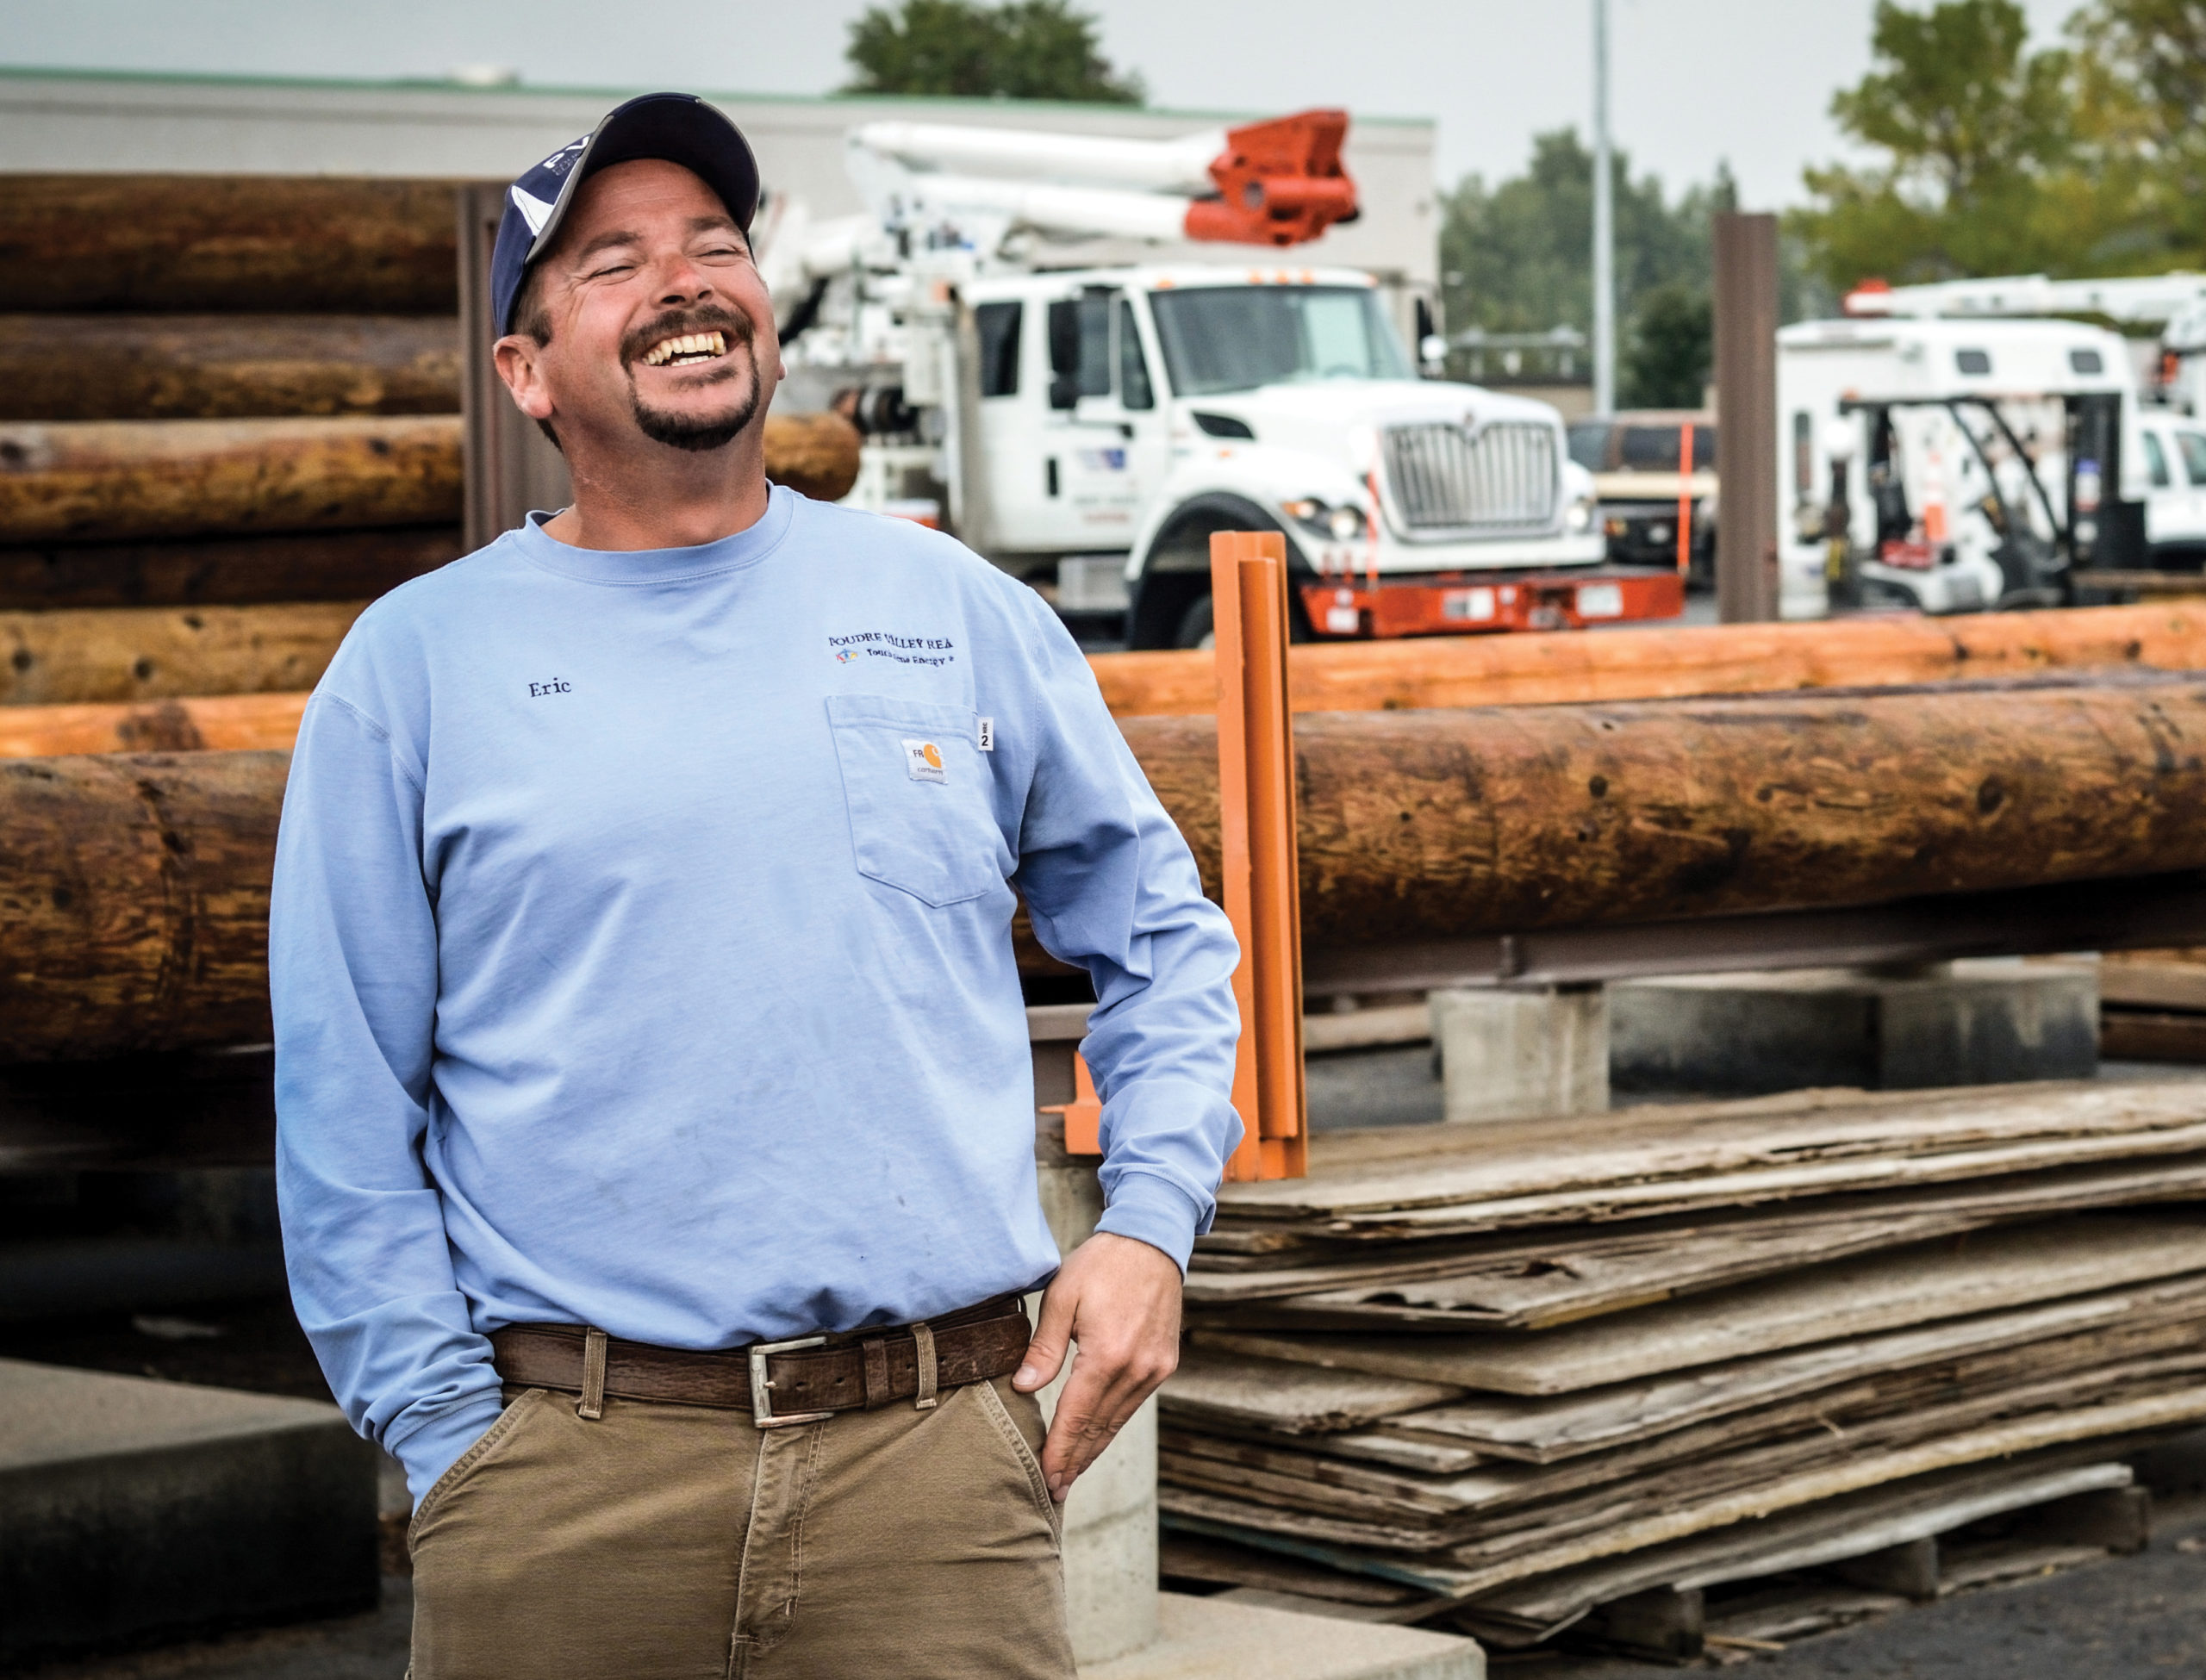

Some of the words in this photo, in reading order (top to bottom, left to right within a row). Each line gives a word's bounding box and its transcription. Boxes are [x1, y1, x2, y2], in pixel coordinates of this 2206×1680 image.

[829, 632, 882, 646] POUDRE
[926, 638, 953, 650] REA
[528, 677, 571, 697] Eric
[981, 735, 988, 746] 2
[913, 750, 925, 758] FR
